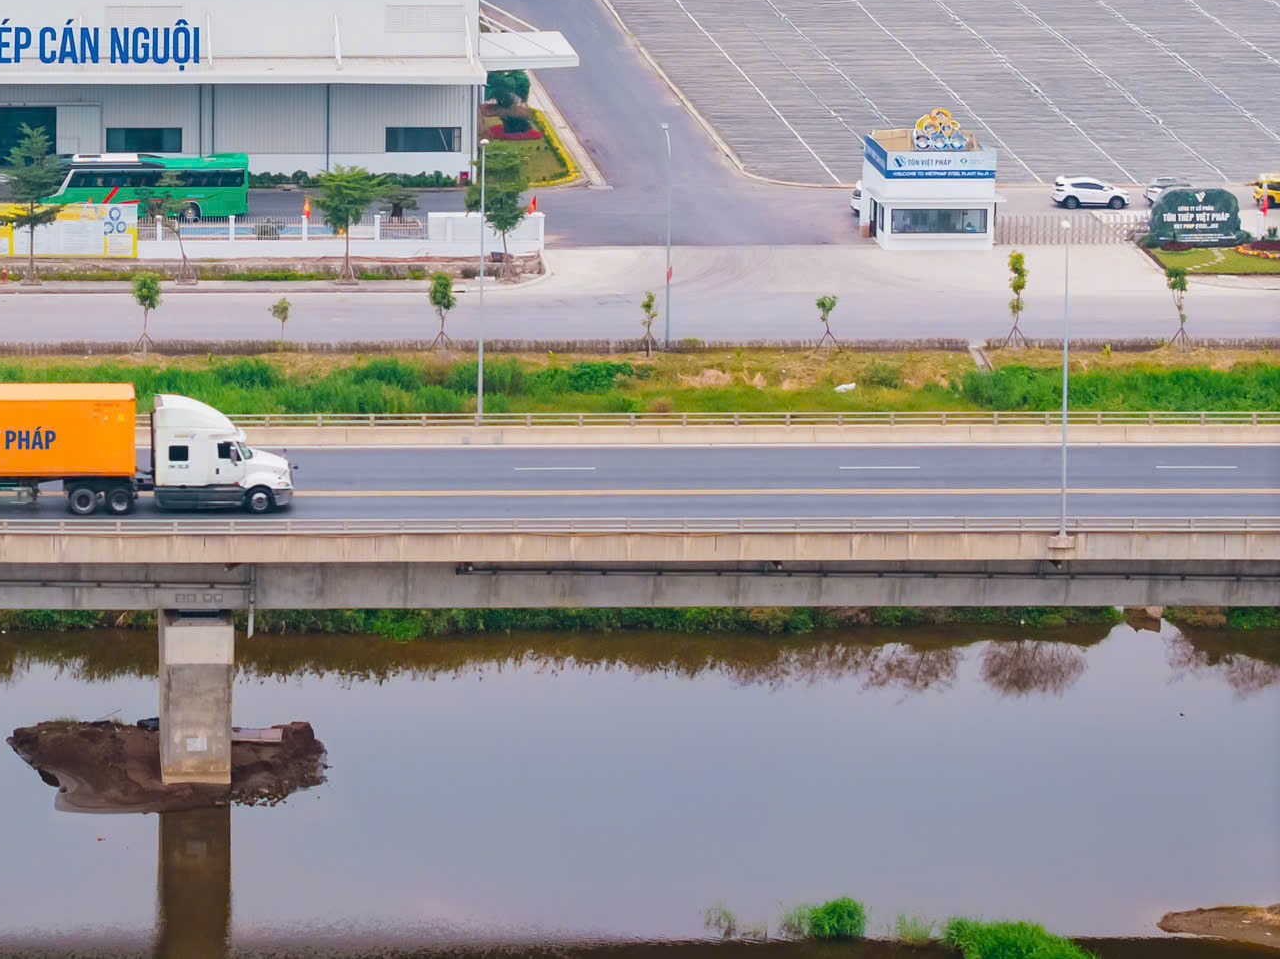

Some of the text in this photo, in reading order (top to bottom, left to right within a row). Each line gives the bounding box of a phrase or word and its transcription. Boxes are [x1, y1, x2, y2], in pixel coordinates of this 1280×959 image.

[39, 18, 100, 64] CÁN
[110, 18, 200, 72] NGUỘI
[5, 426, 57, 450] PHÁP
